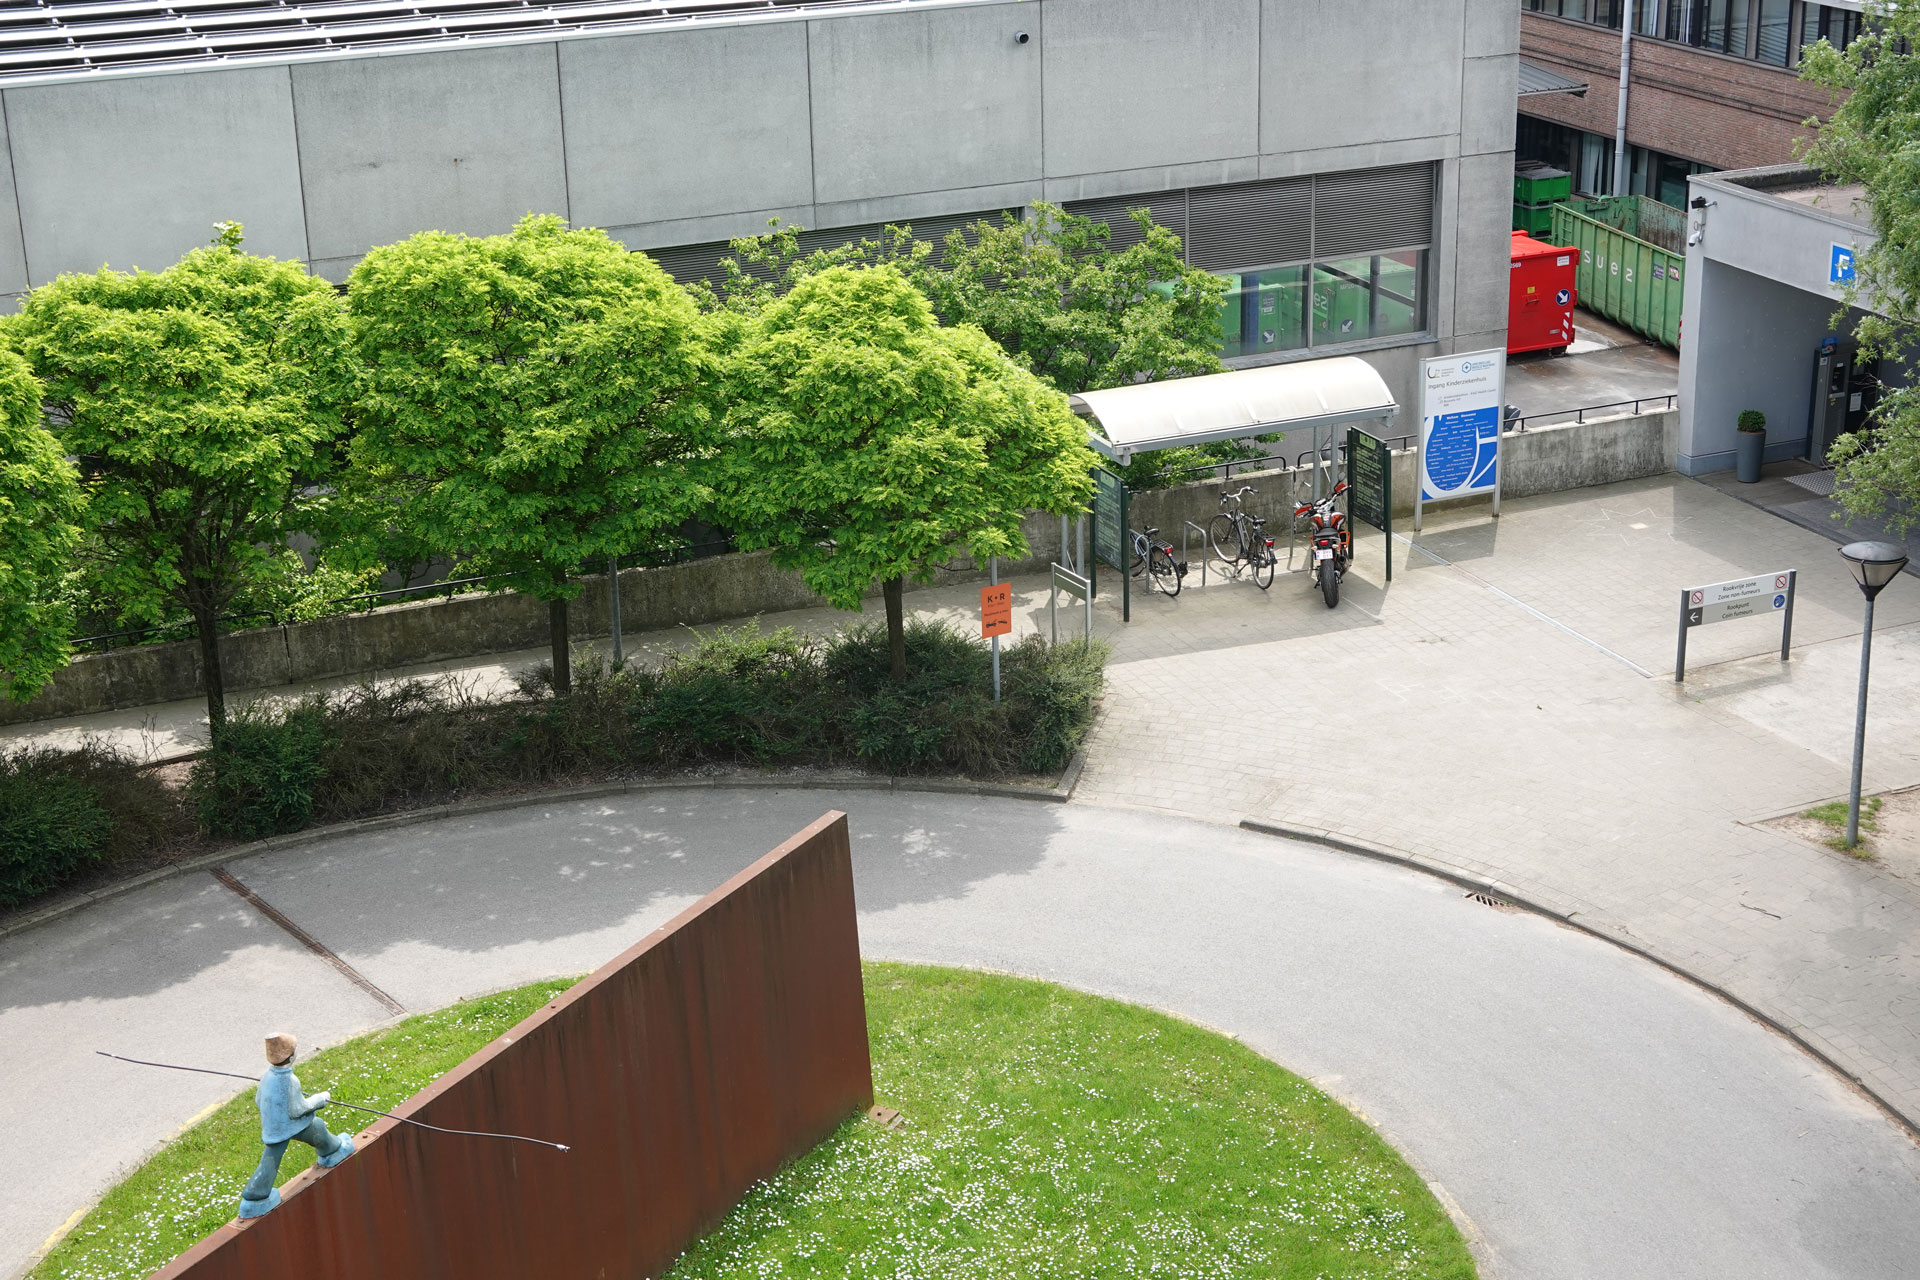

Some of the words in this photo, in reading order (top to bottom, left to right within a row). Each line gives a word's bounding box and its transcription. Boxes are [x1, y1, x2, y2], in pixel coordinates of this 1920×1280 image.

[1583, 250, 1633, 283] suez
[1428, 382, 1446, 390] Ingang
[1446, 376, 1487, 387] Kinderziekenhuis
[1722, 583, 1745, 592] Rookvrije
[1730, 588, 1761, 598] non-fumeurs
[1726, 602, 1750, 611] Rookpunt
[1733, 609, 1753, 617] fumeurs
